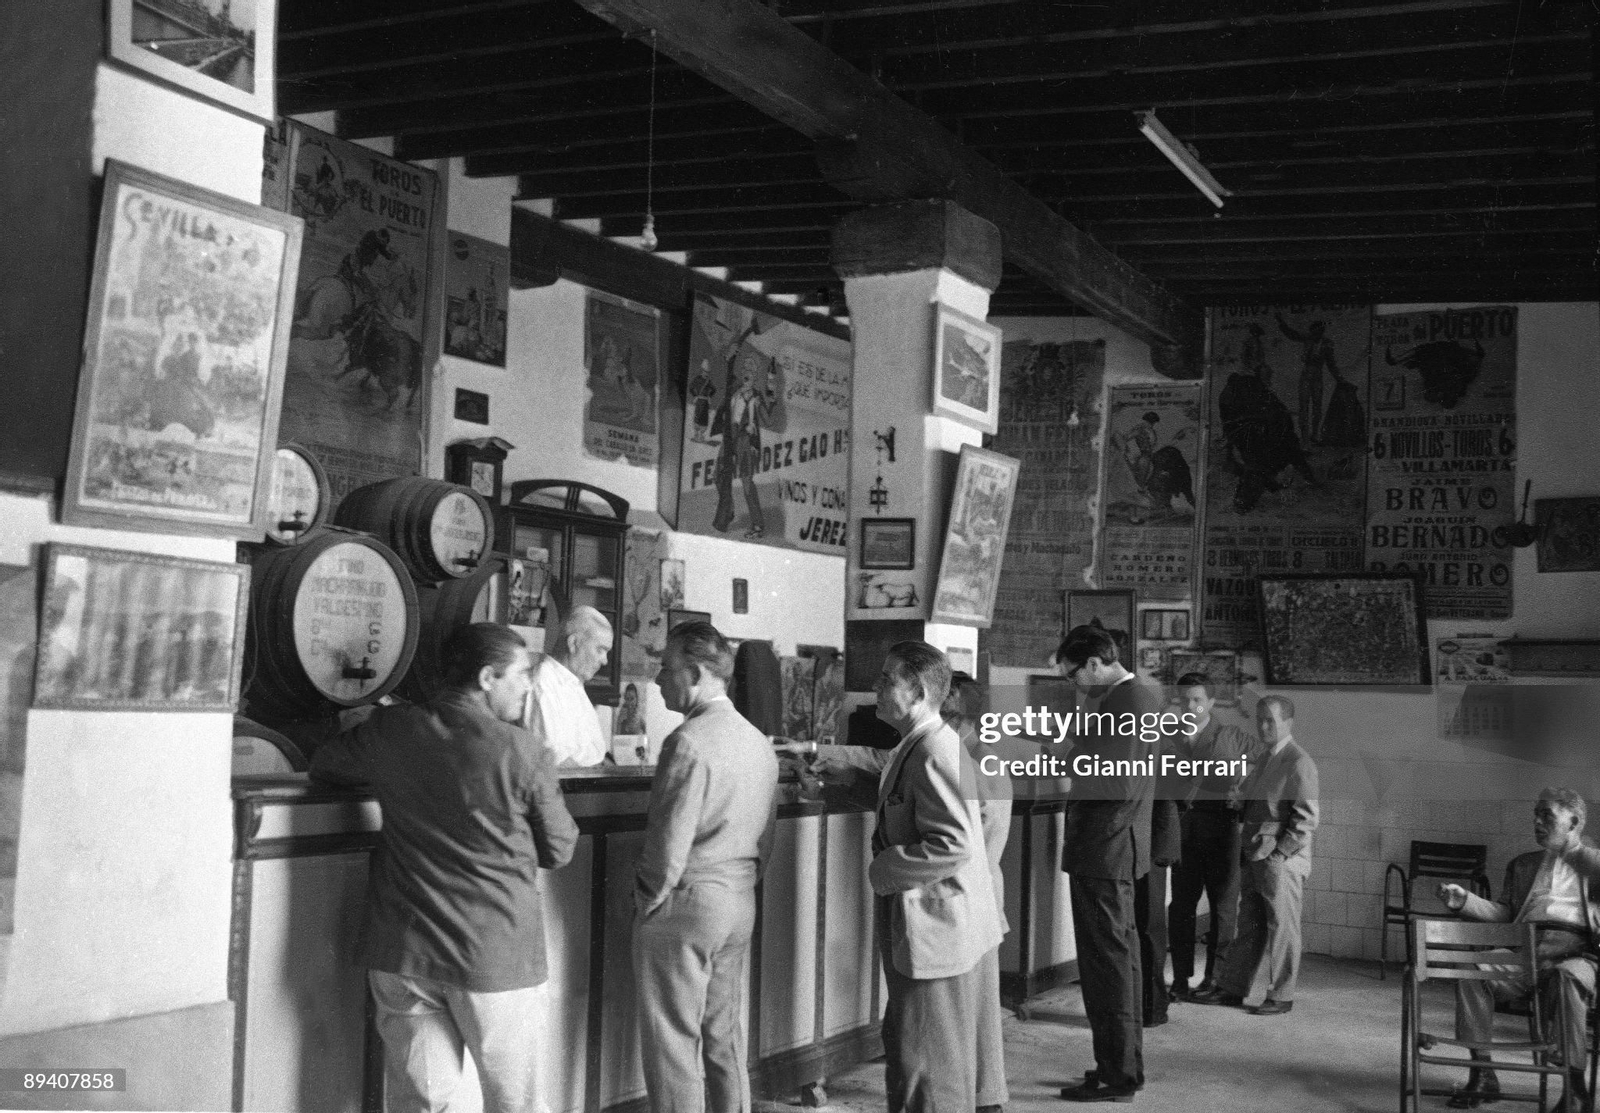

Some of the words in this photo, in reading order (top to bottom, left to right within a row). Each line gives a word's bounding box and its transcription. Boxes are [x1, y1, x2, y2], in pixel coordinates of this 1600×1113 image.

[369, 158, 422, 195] TOROS
[379, 194, 426, 230] PUERTO
[1429, 309, 1514, 341] PUERTO
[1374, 432, 1386, 459] 6
[1498, 428, 1513, 456] 6
[1402, 459, 1511, 473] VILLAMARTA
[1411, 478, 1471, 486] JAIME
[1386, 486, 1498, 511] BRAVO
[799, 516, 847, 546] JEREZ
[1402, 516, 1477, 524] JOAQUIN
[1113, 564, 1185, 573] ROMERO
[1293, 550, 1302, 569] 8
